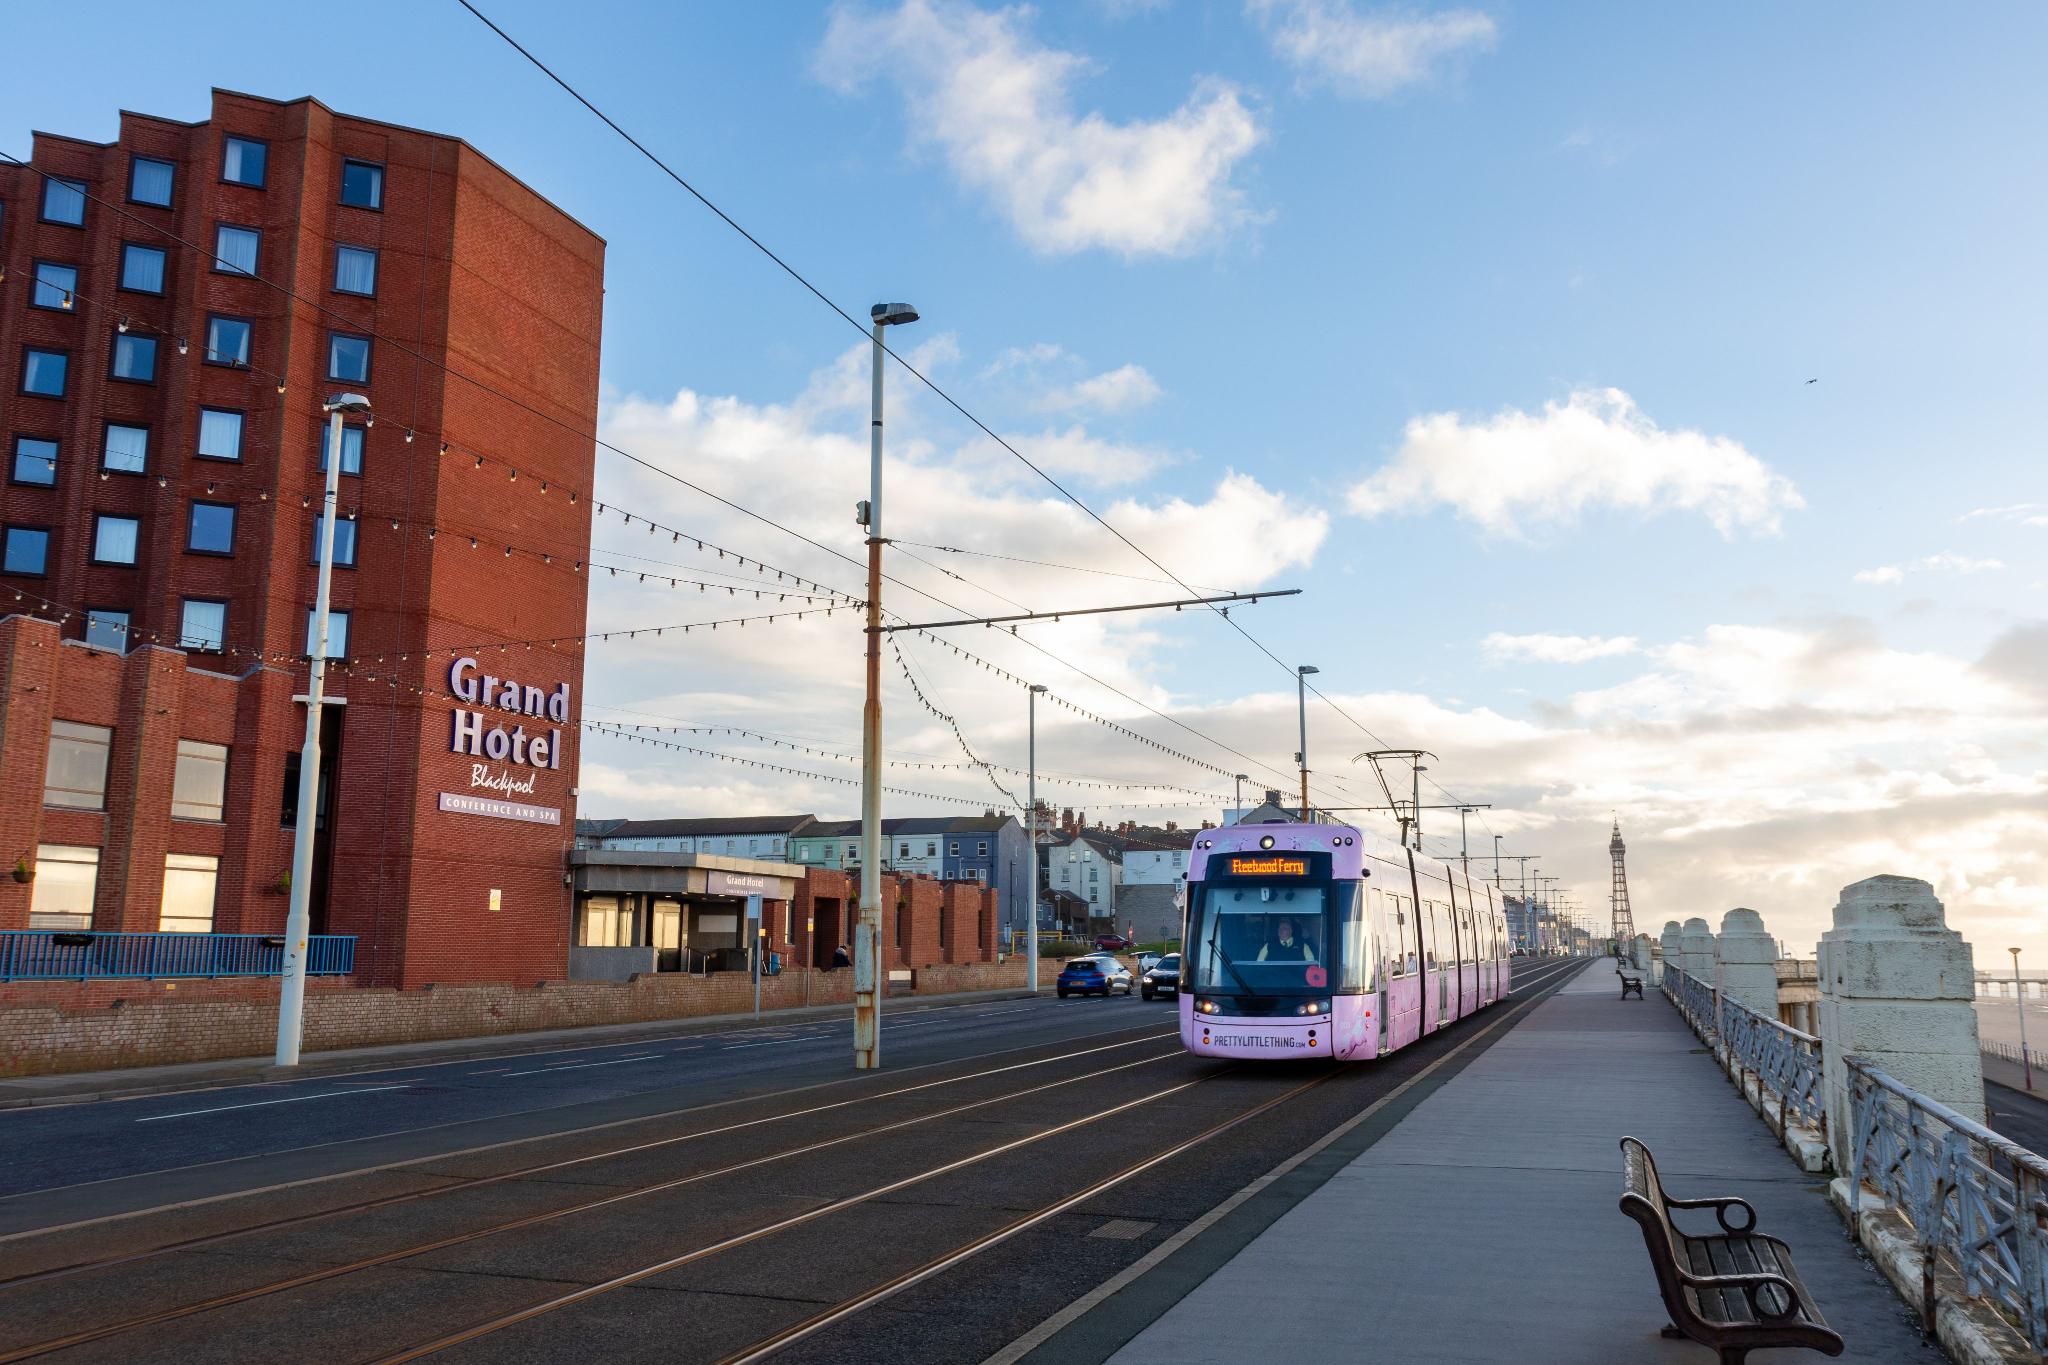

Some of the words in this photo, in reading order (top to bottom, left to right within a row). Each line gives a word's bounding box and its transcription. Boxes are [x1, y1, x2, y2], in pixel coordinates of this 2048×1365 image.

[449, 657, 570, 723] Grand
[452, 708, 561, 770] Hotel
[471, 763, 536, 798] Blackpool
[446, 798, 511, 815] CONFERENCE
[516, 807, 536, 818] AND
[539, 811, 556, 821] SPA
[727, 875, 745, 885] Grand
[747, 877, 763, 887] Hotel
[1232, 858, 1278, 873] Fleetwood
[1278, 858, 1304, 875] Ferry
